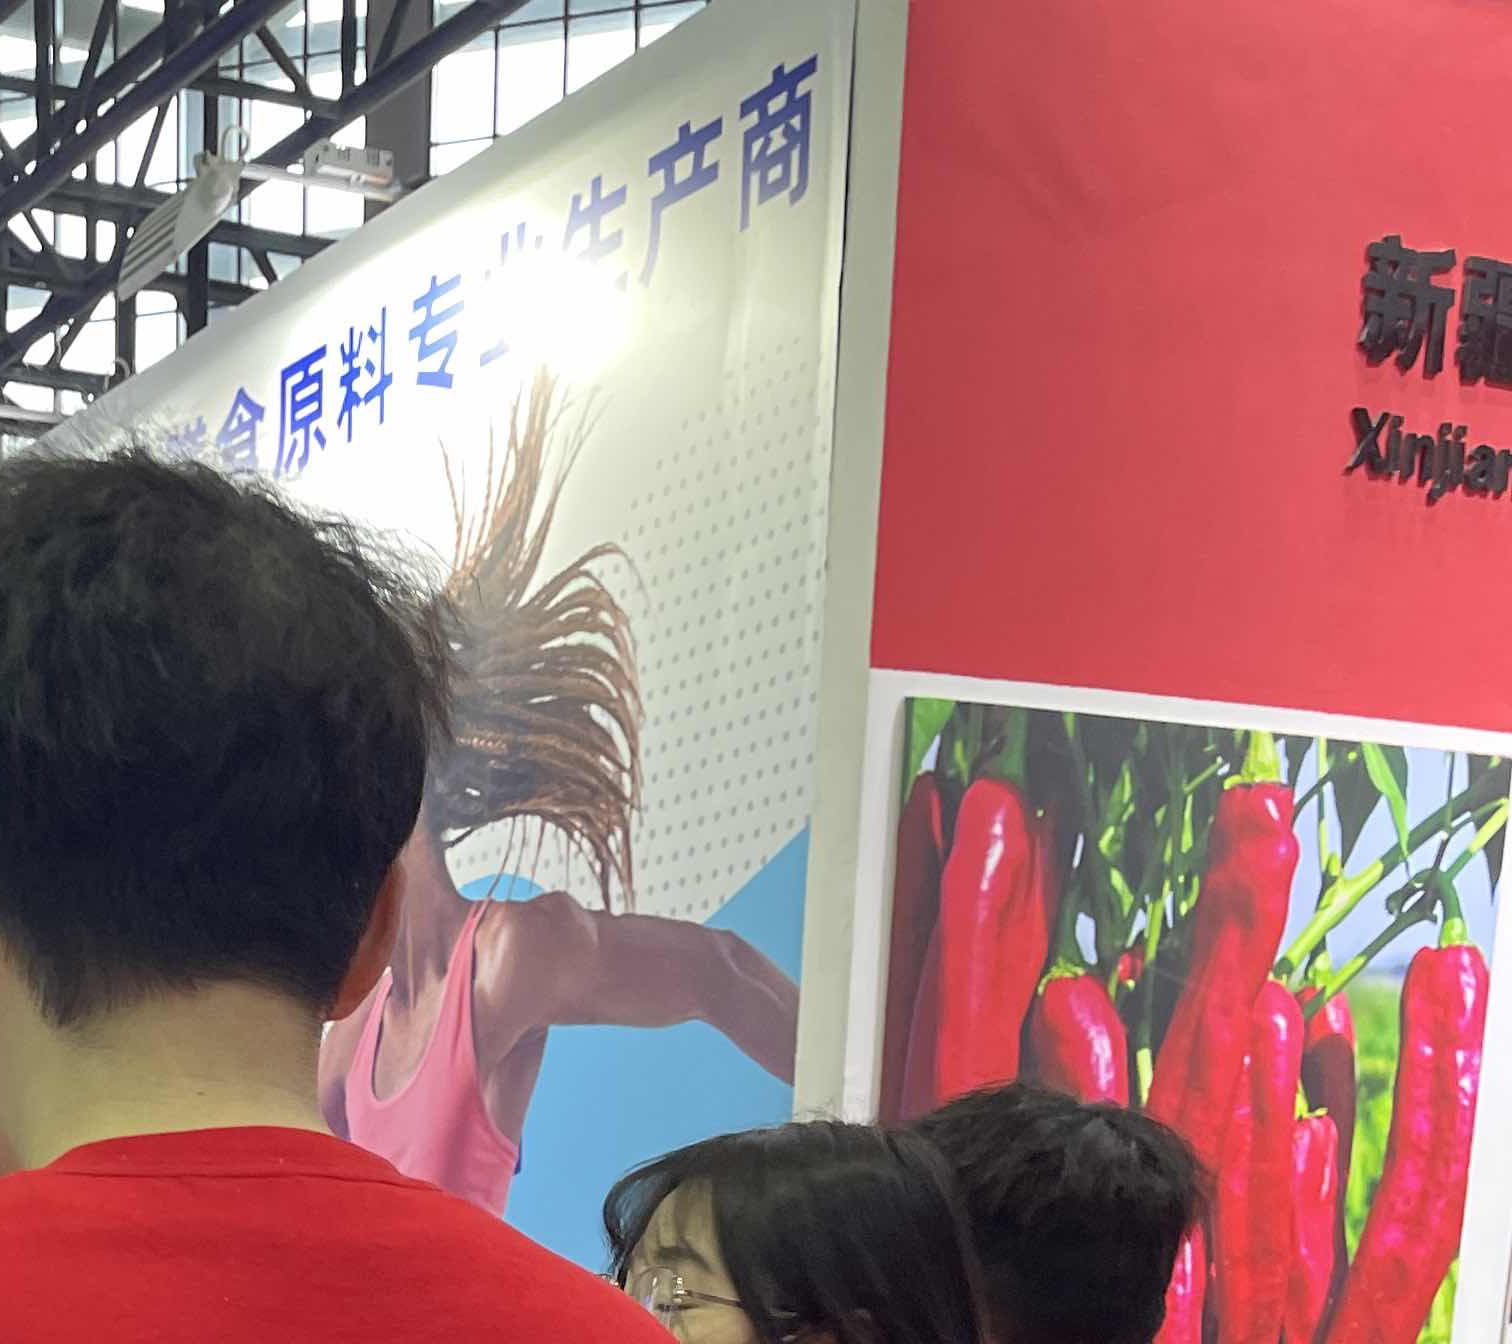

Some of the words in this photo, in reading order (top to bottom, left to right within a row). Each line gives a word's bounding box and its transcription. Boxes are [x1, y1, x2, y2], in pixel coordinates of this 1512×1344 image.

[168, 52, 819, 480] 食原料专生产商
